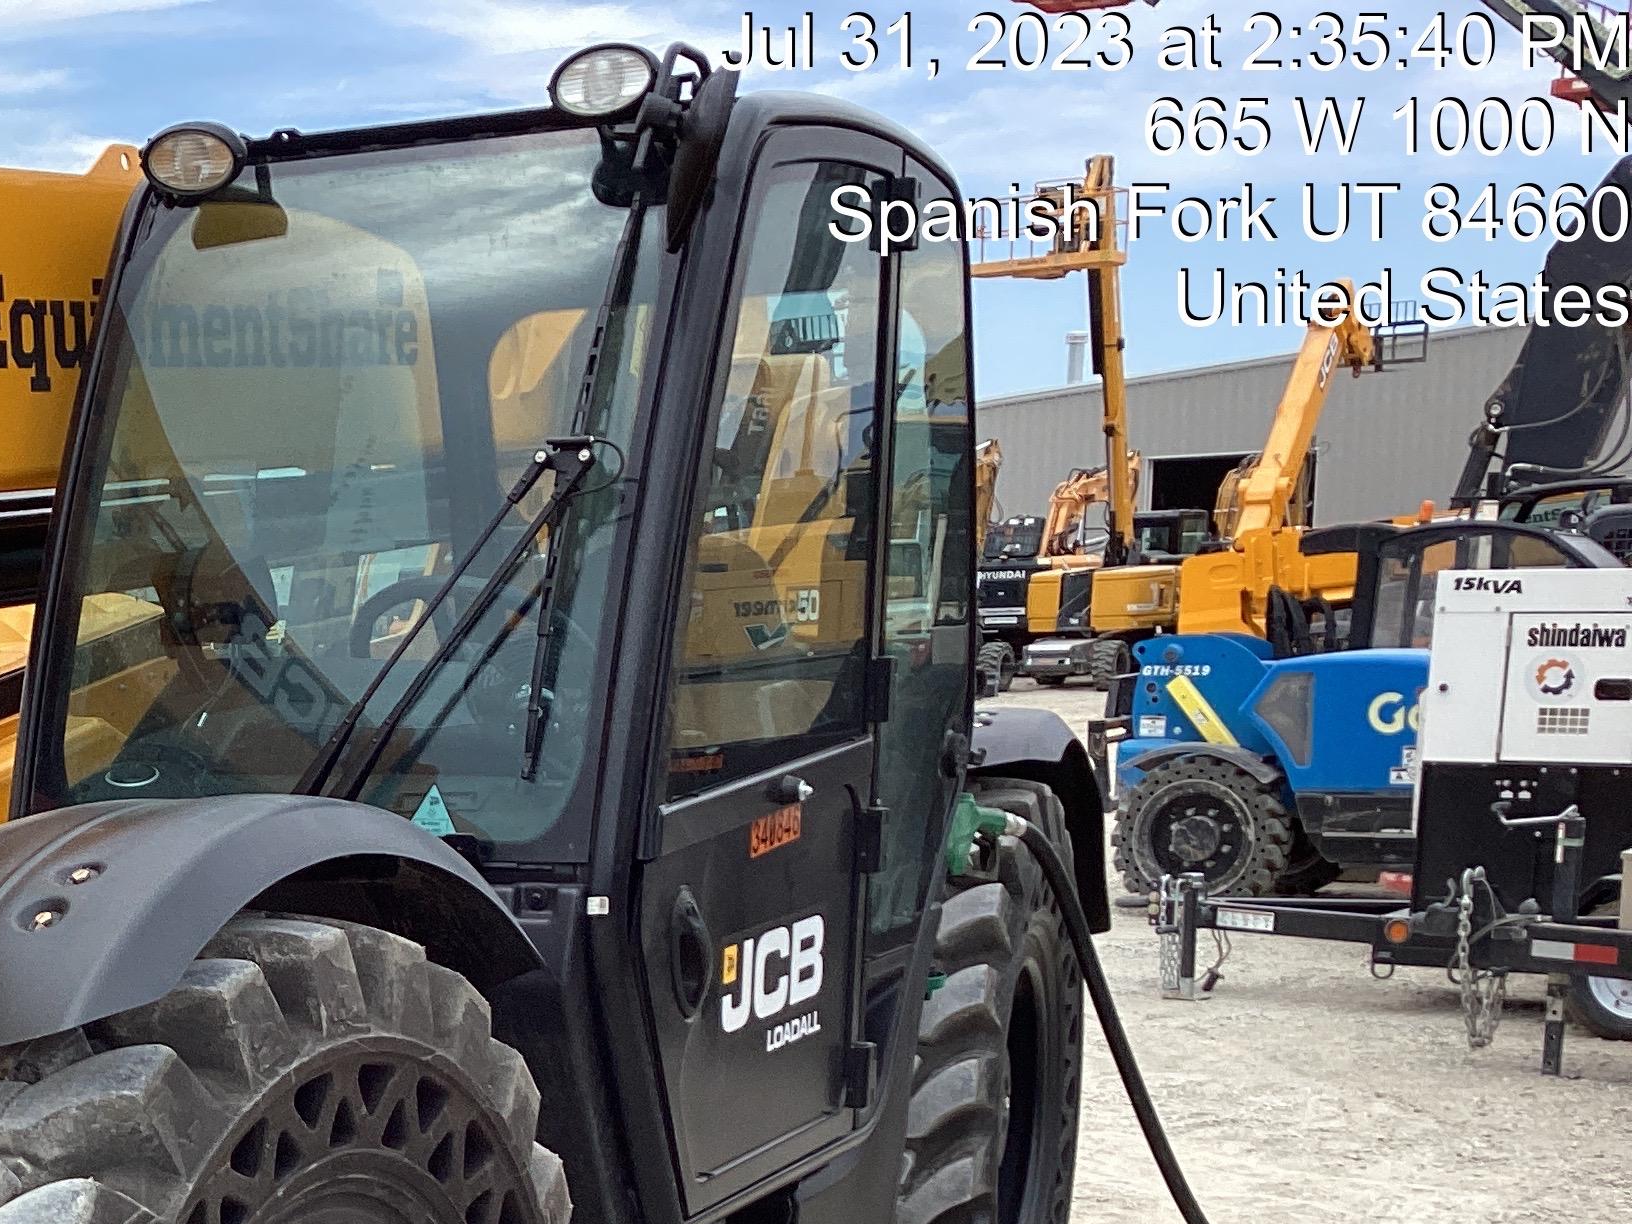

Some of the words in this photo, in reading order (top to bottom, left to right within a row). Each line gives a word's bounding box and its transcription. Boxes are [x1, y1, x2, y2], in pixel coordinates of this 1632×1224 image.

[1319, 332, 1338, 388] JCB
[1453, 577, 1523, 594] 15kVA
[1527, 622, 1626, 648] shindaiwa
[1142, 664, 1211, 677] GTH-5519
[721, 914, 825, 1033] JCB
[766, 1010, 821, 1052] LOADALL
